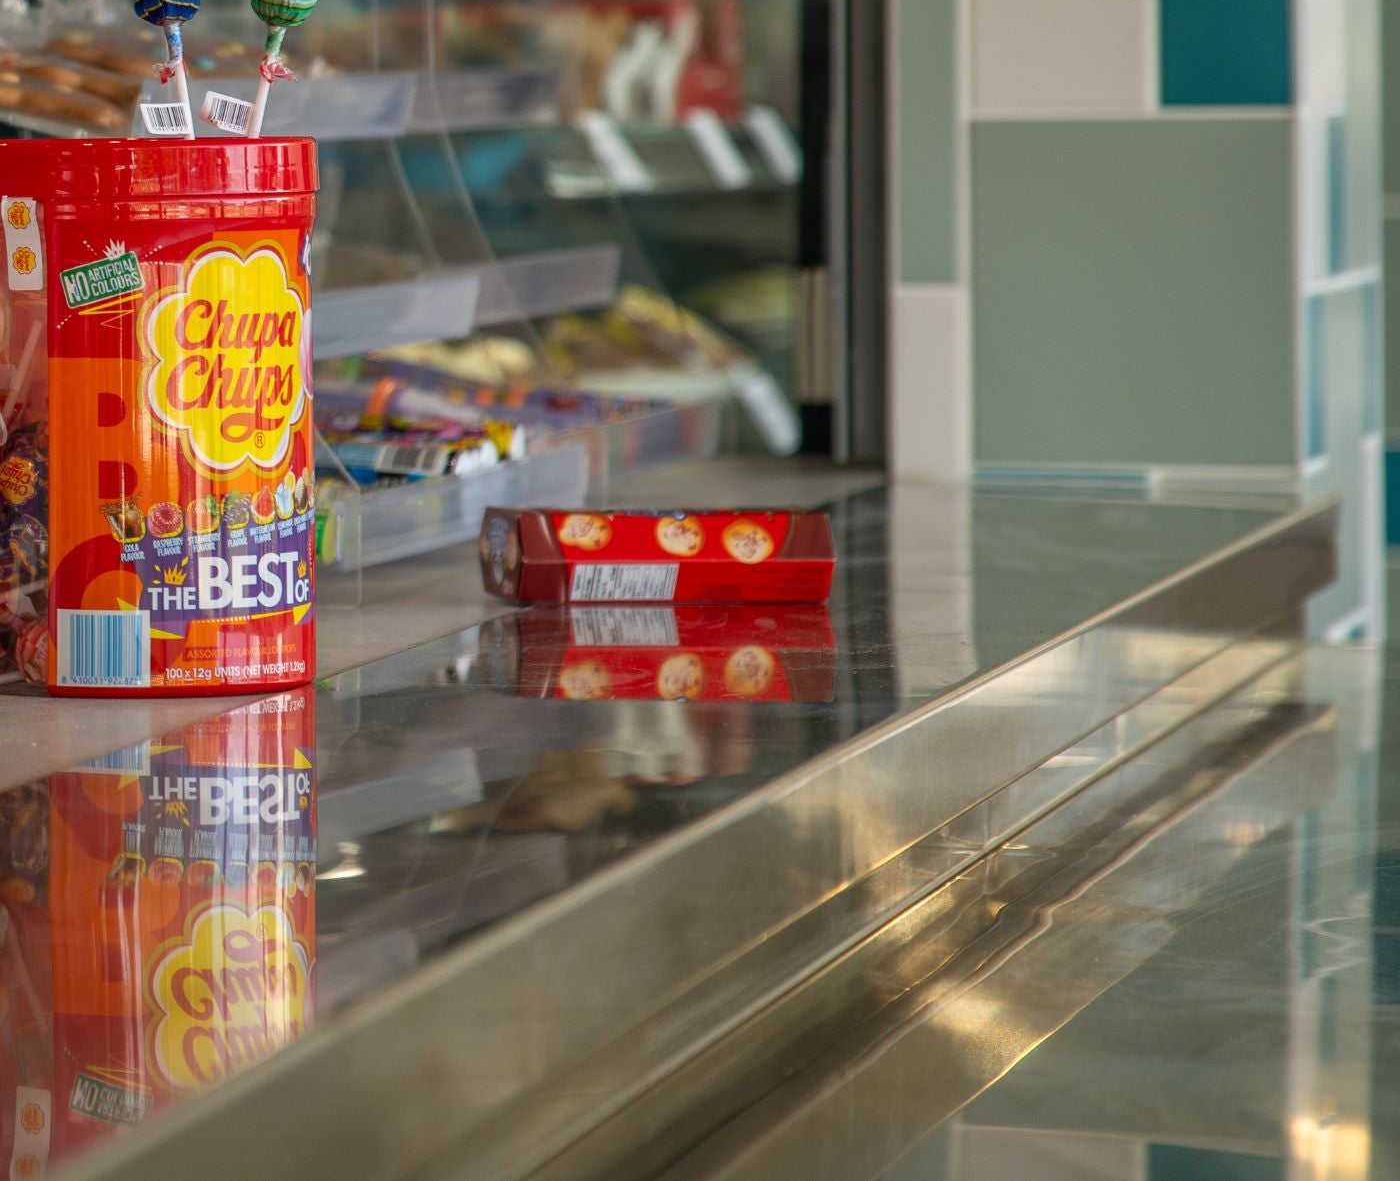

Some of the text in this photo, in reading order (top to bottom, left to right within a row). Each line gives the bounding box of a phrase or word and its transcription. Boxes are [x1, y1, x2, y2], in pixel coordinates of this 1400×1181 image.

[88, 258, 136, 281] ARTIFICIAL
[64, 271, 90, 304] NO
[90, 271, 140, 296] COLOURS
[174, 299, 297, 364] Chupa
[166, 354, 295, 443] Chups
[124, 543, 139, 552] COLA
[153, 537, 183, 549] RASPBERRY
[157, 546, 181, 557] FLAVOUR
[120, 551, 145, 562] FLAVOUR
[148, 551, 309, 611] THE BEST OF
[165, 668, 182, 679] 100
[193, 667, 212, 681] 12g
[214, 666, 240, 678] UNITS
[243, 664, 261, 679] (NET
[262, 663, 289, 676] WEIGHT
